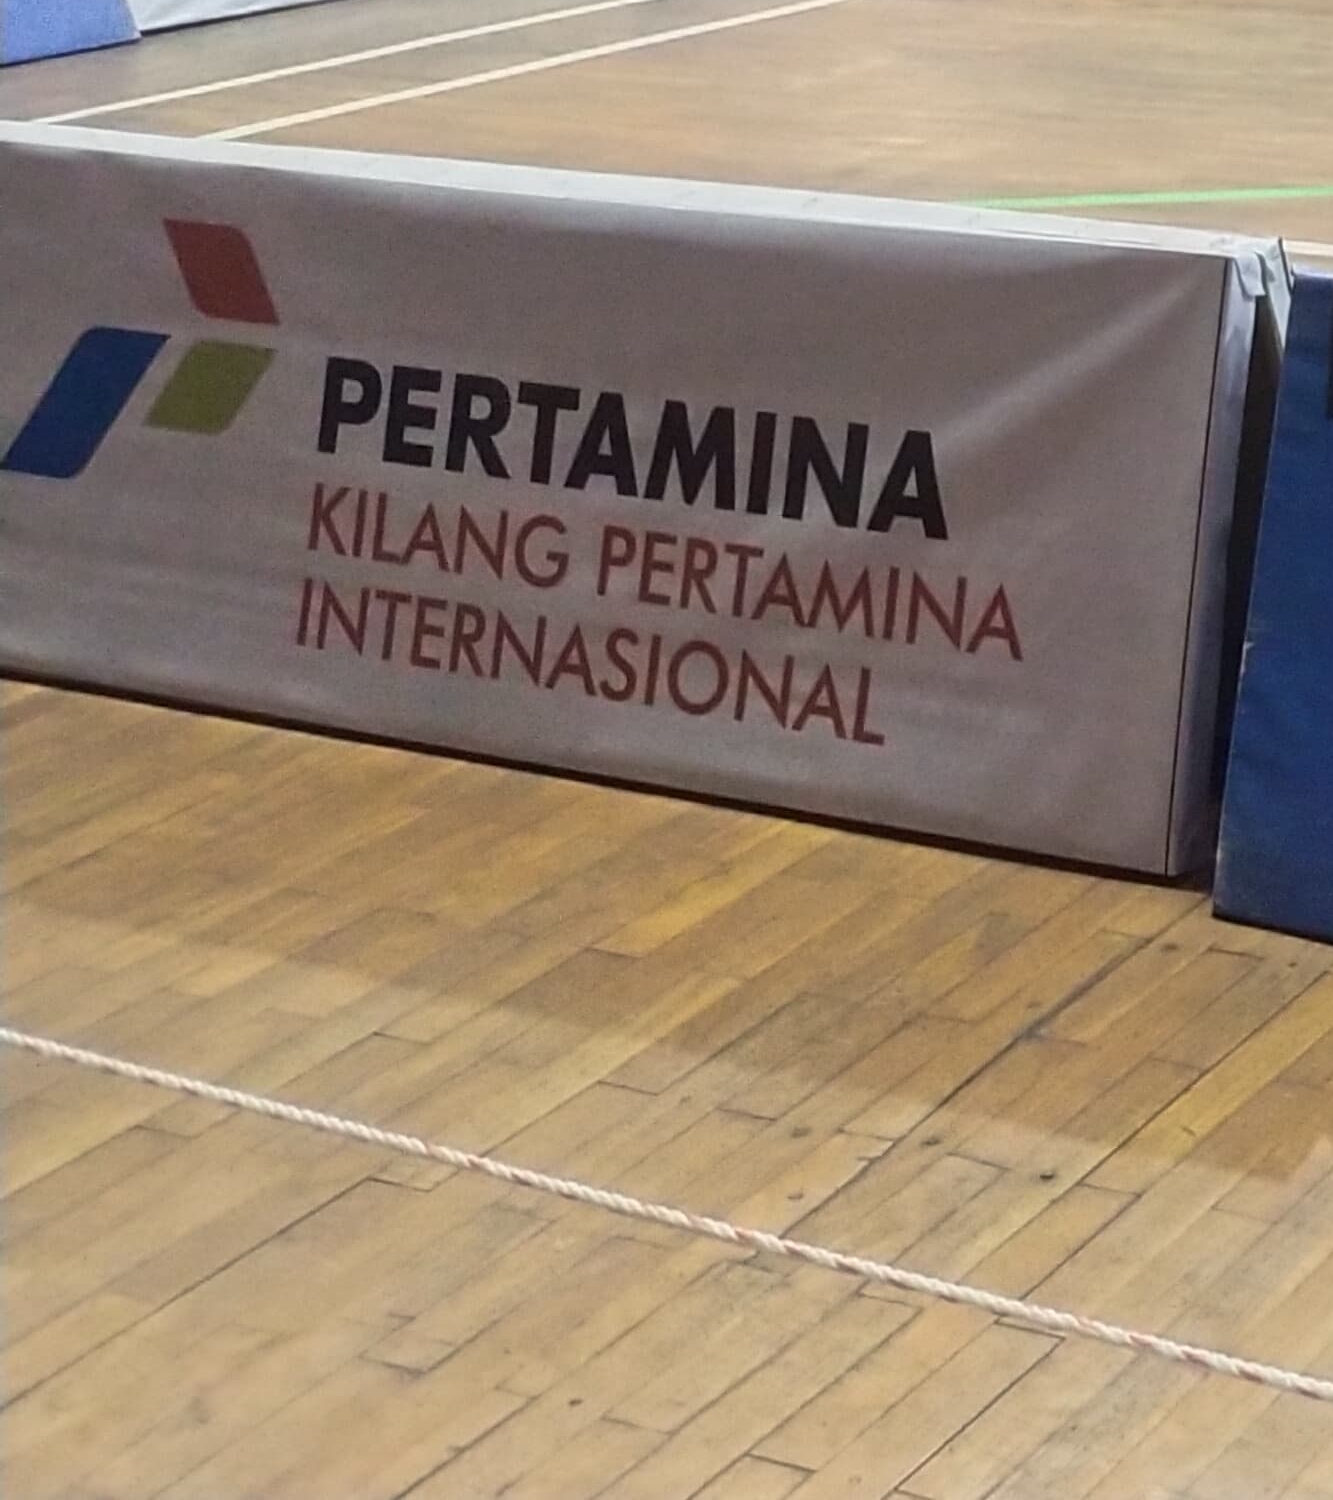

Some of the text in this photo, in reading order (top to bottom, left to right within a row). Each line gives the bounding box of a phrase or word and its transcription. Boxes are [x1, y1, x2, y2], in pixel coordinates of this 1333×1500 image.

[319, 355, 949, 540] PERTAMINA
[306, 482, 1024, 660] KILANG PERTAMINA
[295, 576, 888, 747] INTERNASIONAL
